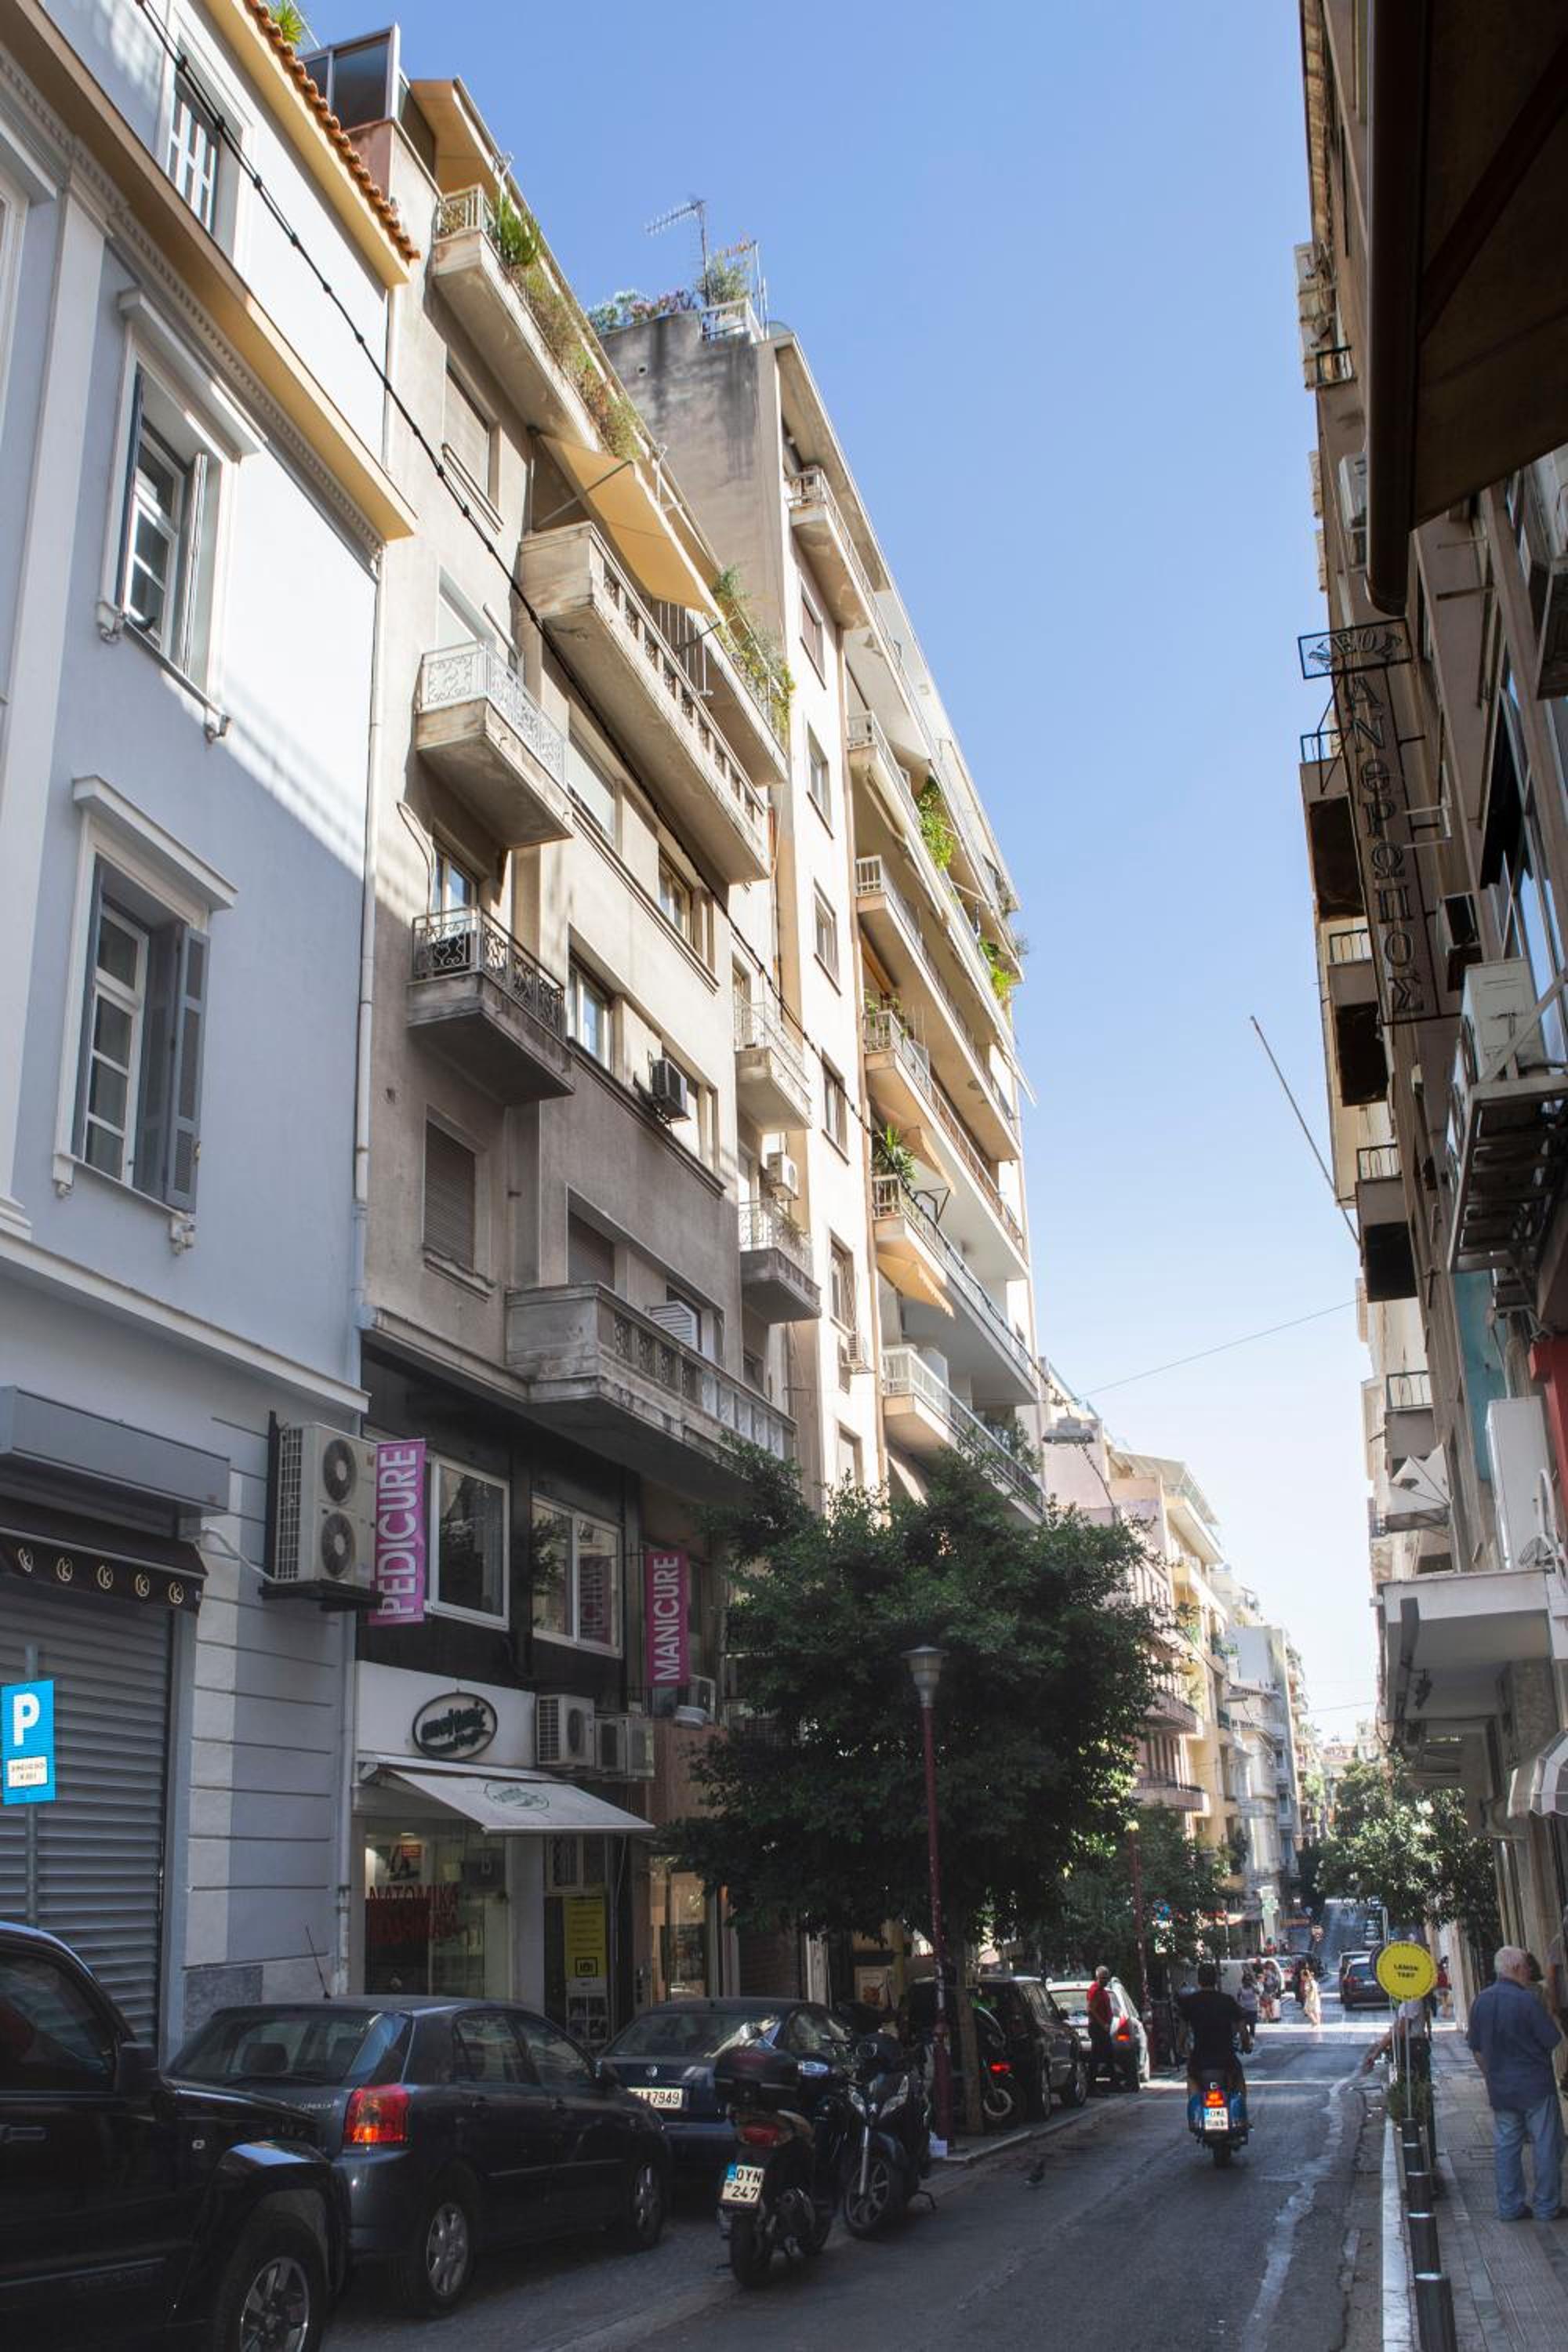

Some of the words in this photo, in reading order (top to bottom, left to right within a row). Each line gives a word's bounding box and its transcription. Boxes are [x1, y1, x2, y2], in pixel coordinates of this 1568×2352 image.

[1308, 630, 1403, 672] ΝΕΟΣ
[1350, 676, 1424, 1013] ΑΝΘΡΩΠΟΣ
[377, 1450, 417, 1616] PEDICURE
[653, 1556, 680, 1681] MANICURE
[13, 1693, 40, 1747] P
[731, 2185, 758, 2200] 247
